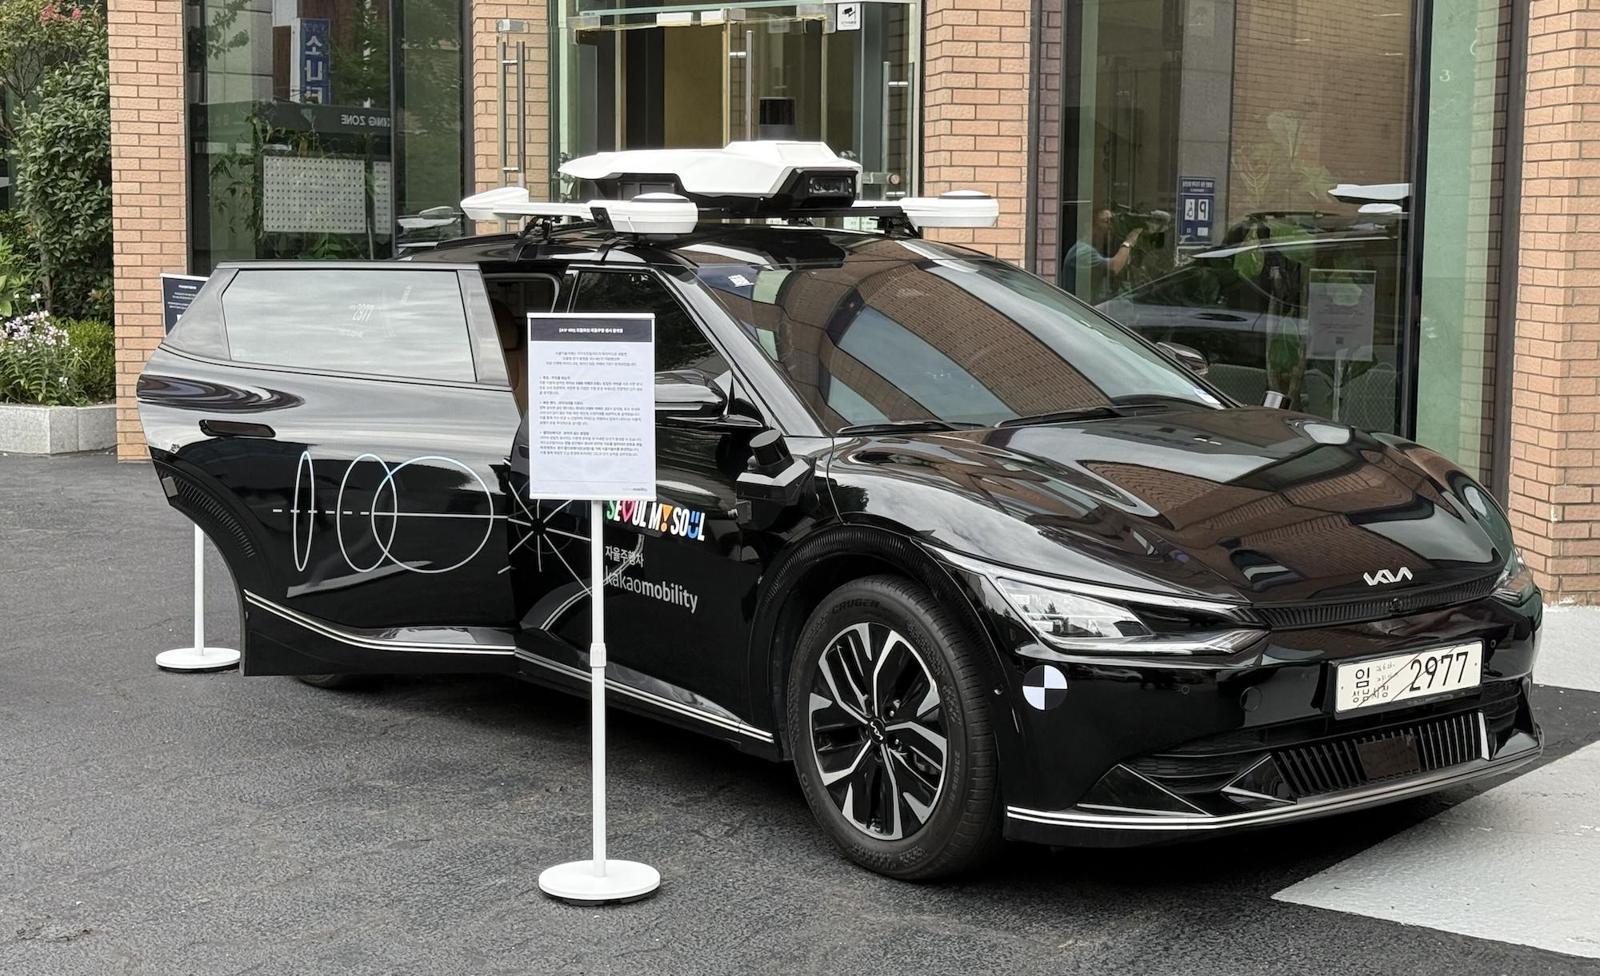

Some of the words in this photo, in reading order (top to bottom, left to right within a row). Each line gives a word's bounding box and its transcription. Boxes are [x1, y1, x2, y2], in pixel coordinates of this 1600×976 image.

[670, 507, 705, 541] SOUL
[605, 545, 644, 568] 자율주행차
[605, 565, 698, 614] kakaomobility
[1355, 667, 1370, 689] 임
[1409, 651, 1469, 692] 2977
